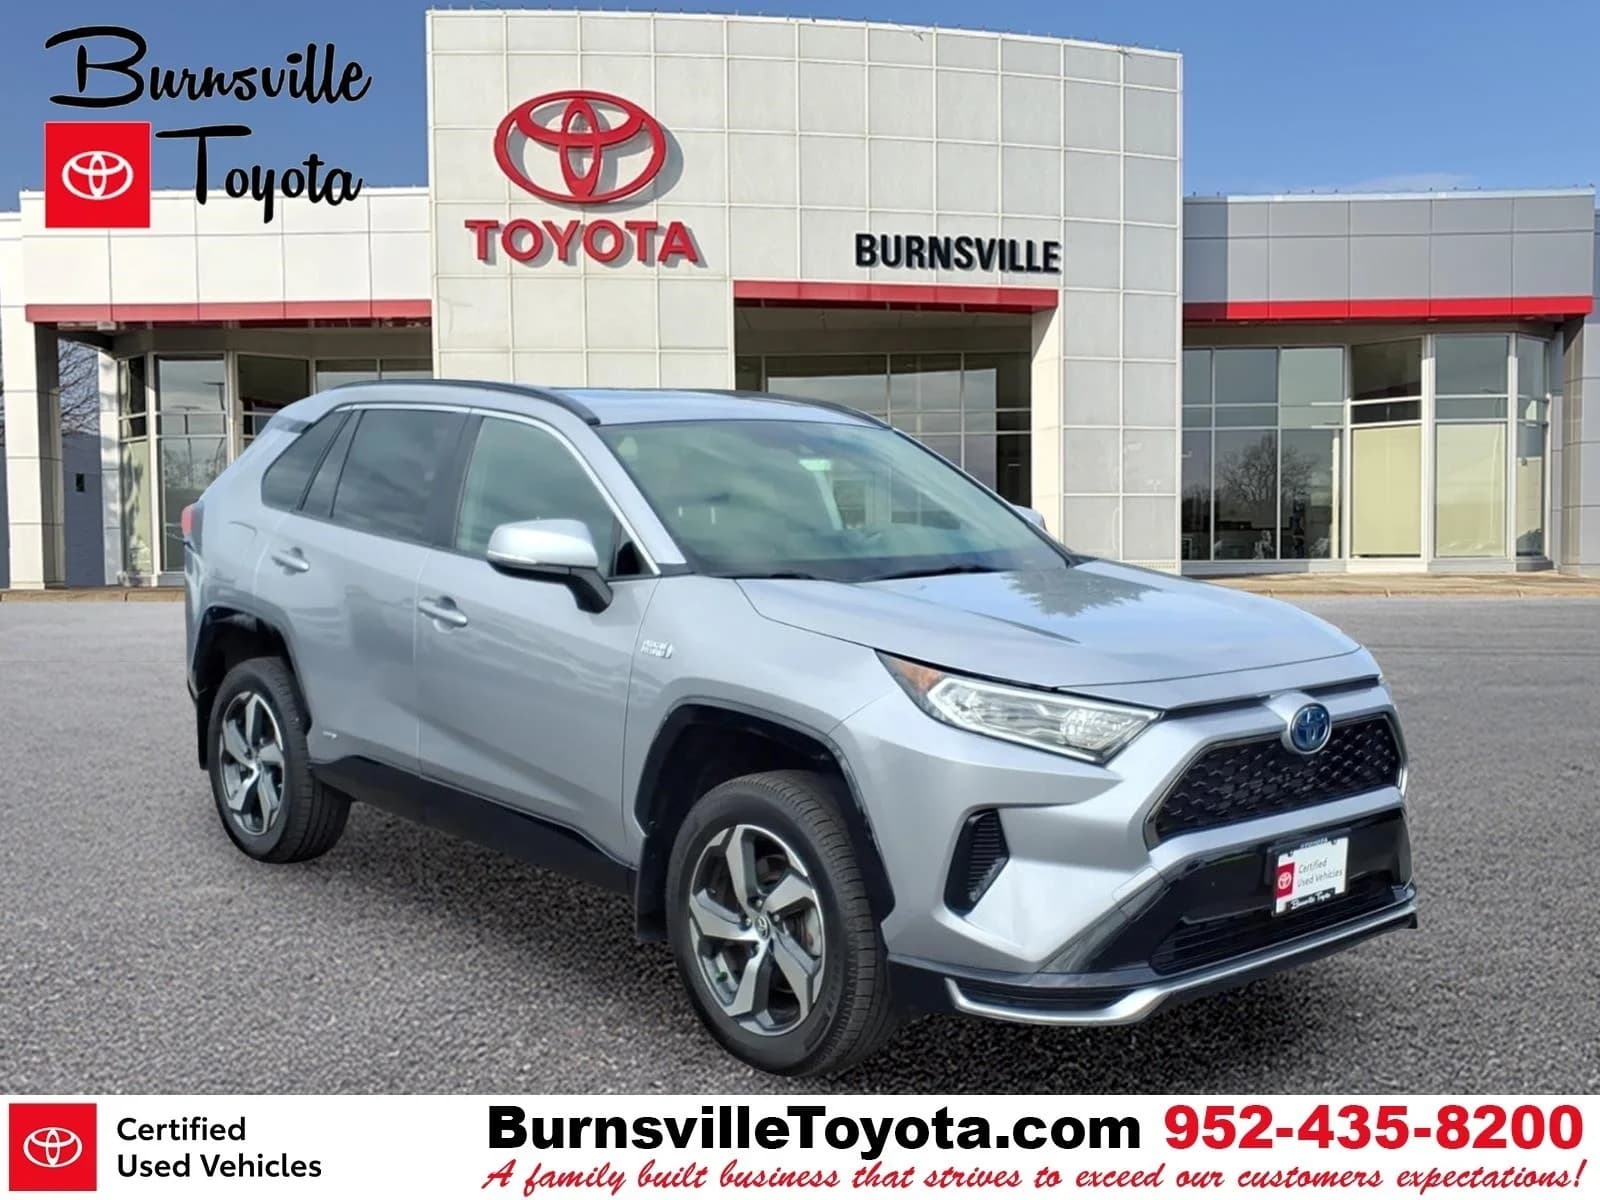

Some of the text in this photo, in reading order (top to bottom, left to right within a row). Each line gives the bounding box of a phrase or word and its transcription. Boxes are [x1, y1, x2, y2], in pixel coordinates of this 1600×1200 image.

[465, 219, 698, 263] TOYOTA
[855, 233, 1061, 273] BURNSVILLE
[1298, 857, 1327, 874] Certified
[1315, 869, 1343, 883] Vehicles
